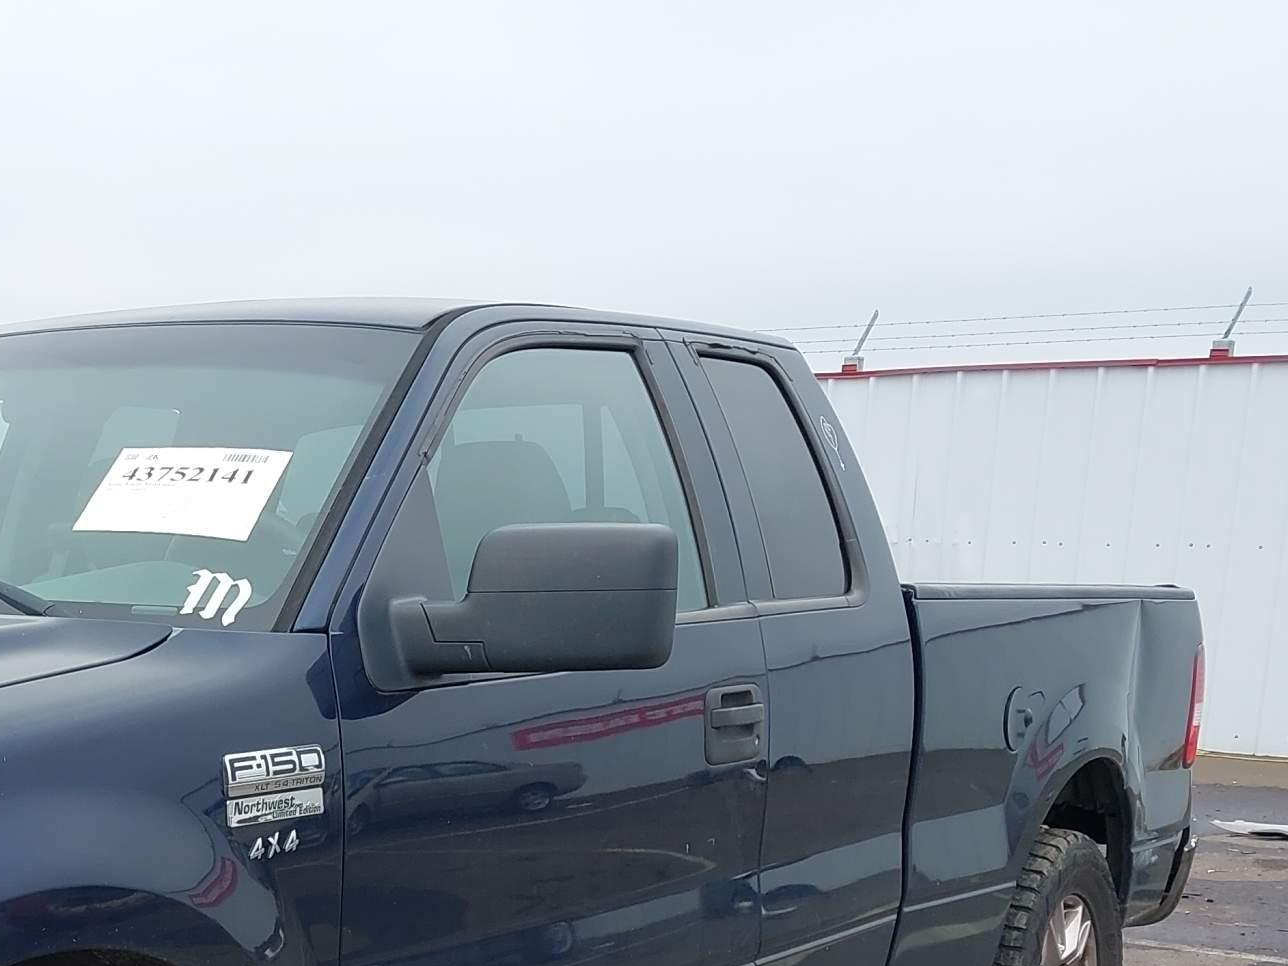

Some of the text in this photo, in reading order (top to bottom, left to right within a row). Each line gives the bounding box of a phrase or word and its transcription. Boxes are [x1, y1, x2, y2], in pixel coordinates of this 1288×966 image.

[122, 466, 254, 485] 43752141
[228, 749, 324, 783] F-150
[254, 782, 270, 792] XLT
[292, 775, 323, 786] TRITON
[233, 796, 295, 816] Northwest
[272, 804, 321, 819] Limited Edition
